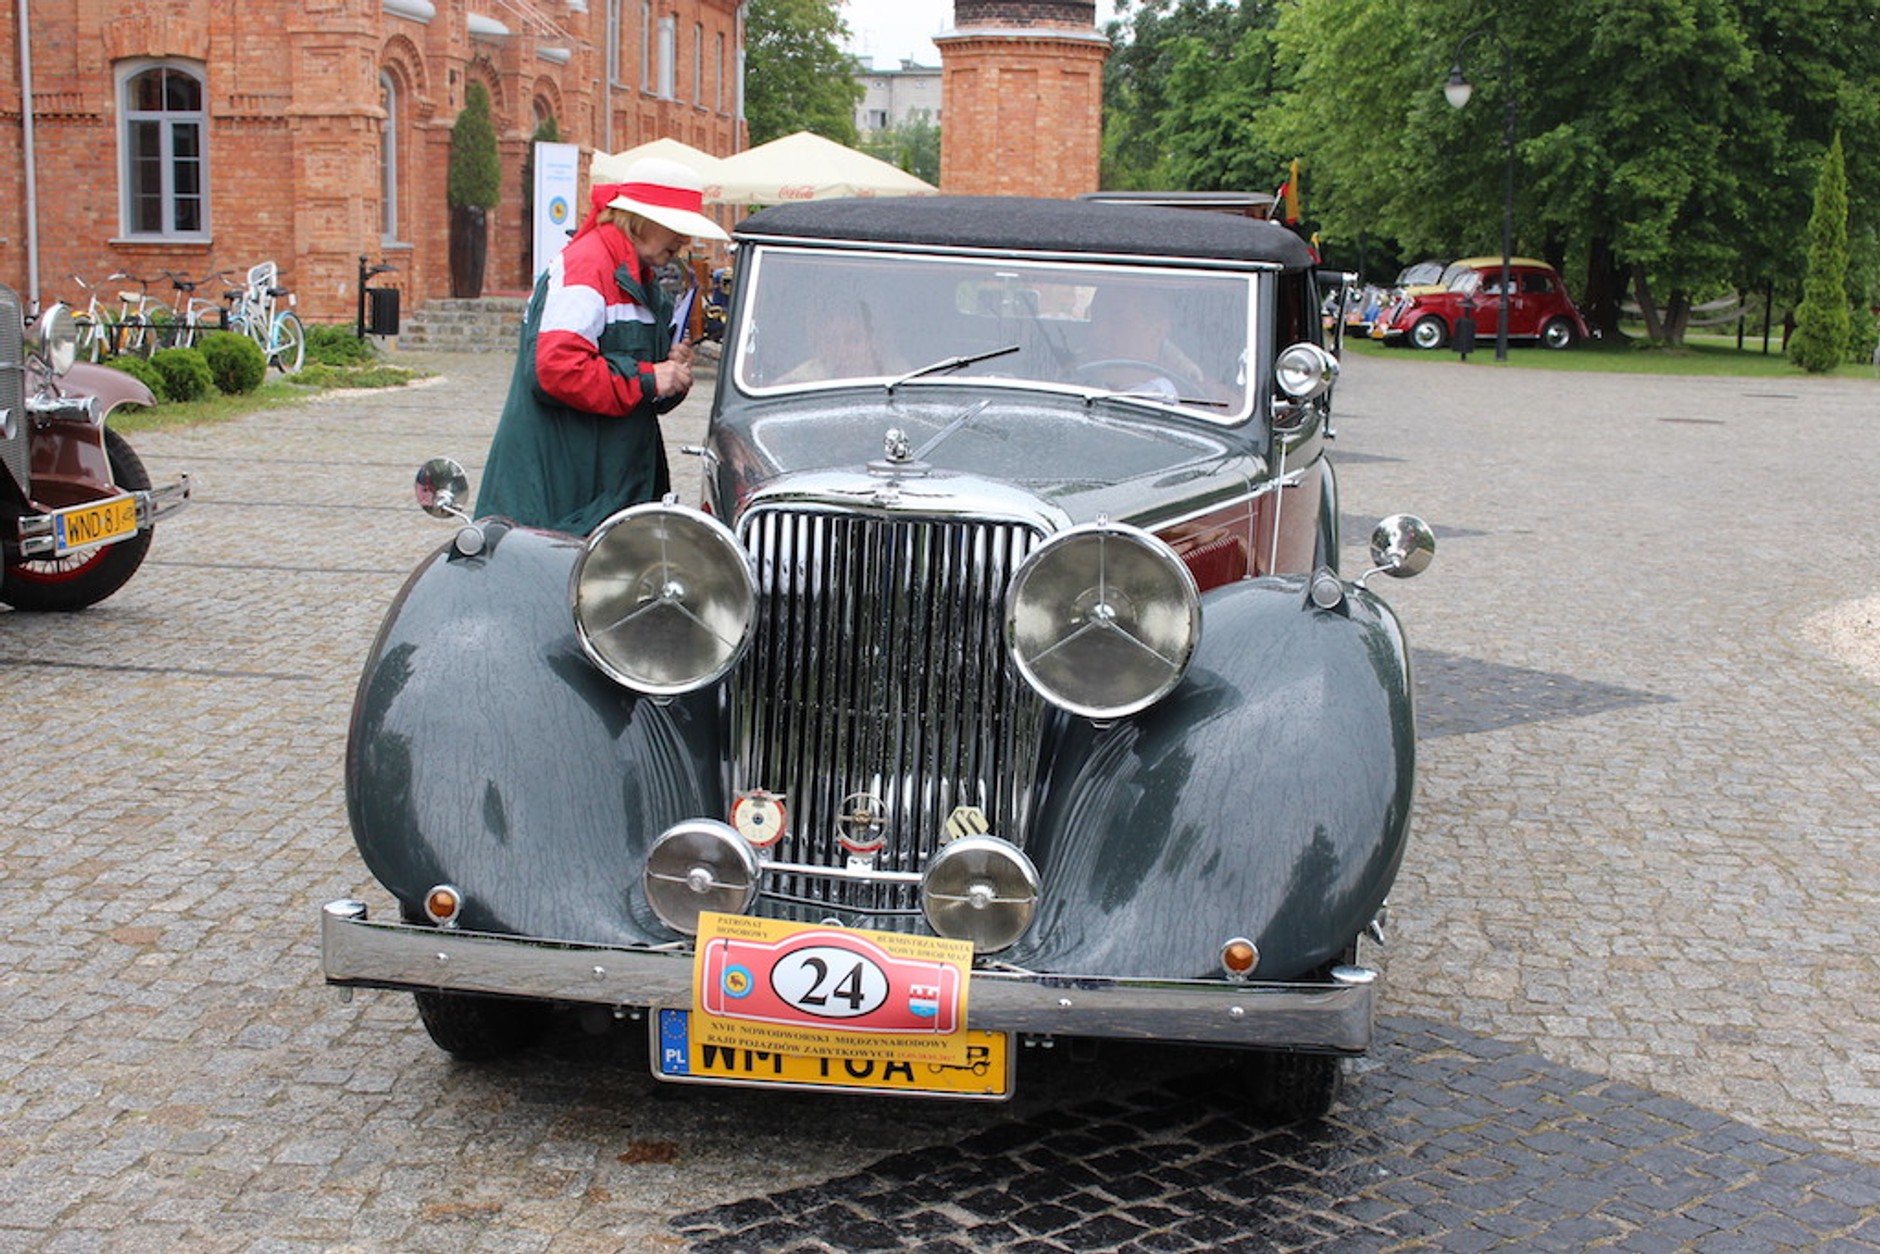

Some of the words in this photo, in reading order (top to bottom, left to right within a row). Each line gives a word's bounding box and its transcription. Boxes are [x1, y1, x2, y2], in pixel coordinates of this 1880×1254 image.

[67, 513, 100, 543] WND
[718, 916, 762, 928] PATRONAT
[716, 926, 768, 938] HONOROWY
[877, 935, 934, 949] BURMISTRZA
[936, 941, 970, 952] MIASTA
[888, 946, 914, 956] NOWY
[798, 957, 865, 1010] 24
[711, 1022, 735, 1032] XVII
[740, 1026, 829, 1043] NOWODWORSKI
[835, 1035, 948, 1049] MIĘDZYNARODOWY
[707, 1034, 736, 1045] RAJD
[738, 1038, 800, 1053] POJAZDÓW
[804, 1046, 894, 1058] ZABYTKOWYCH
[665, 1049, 686, 1063] PL
